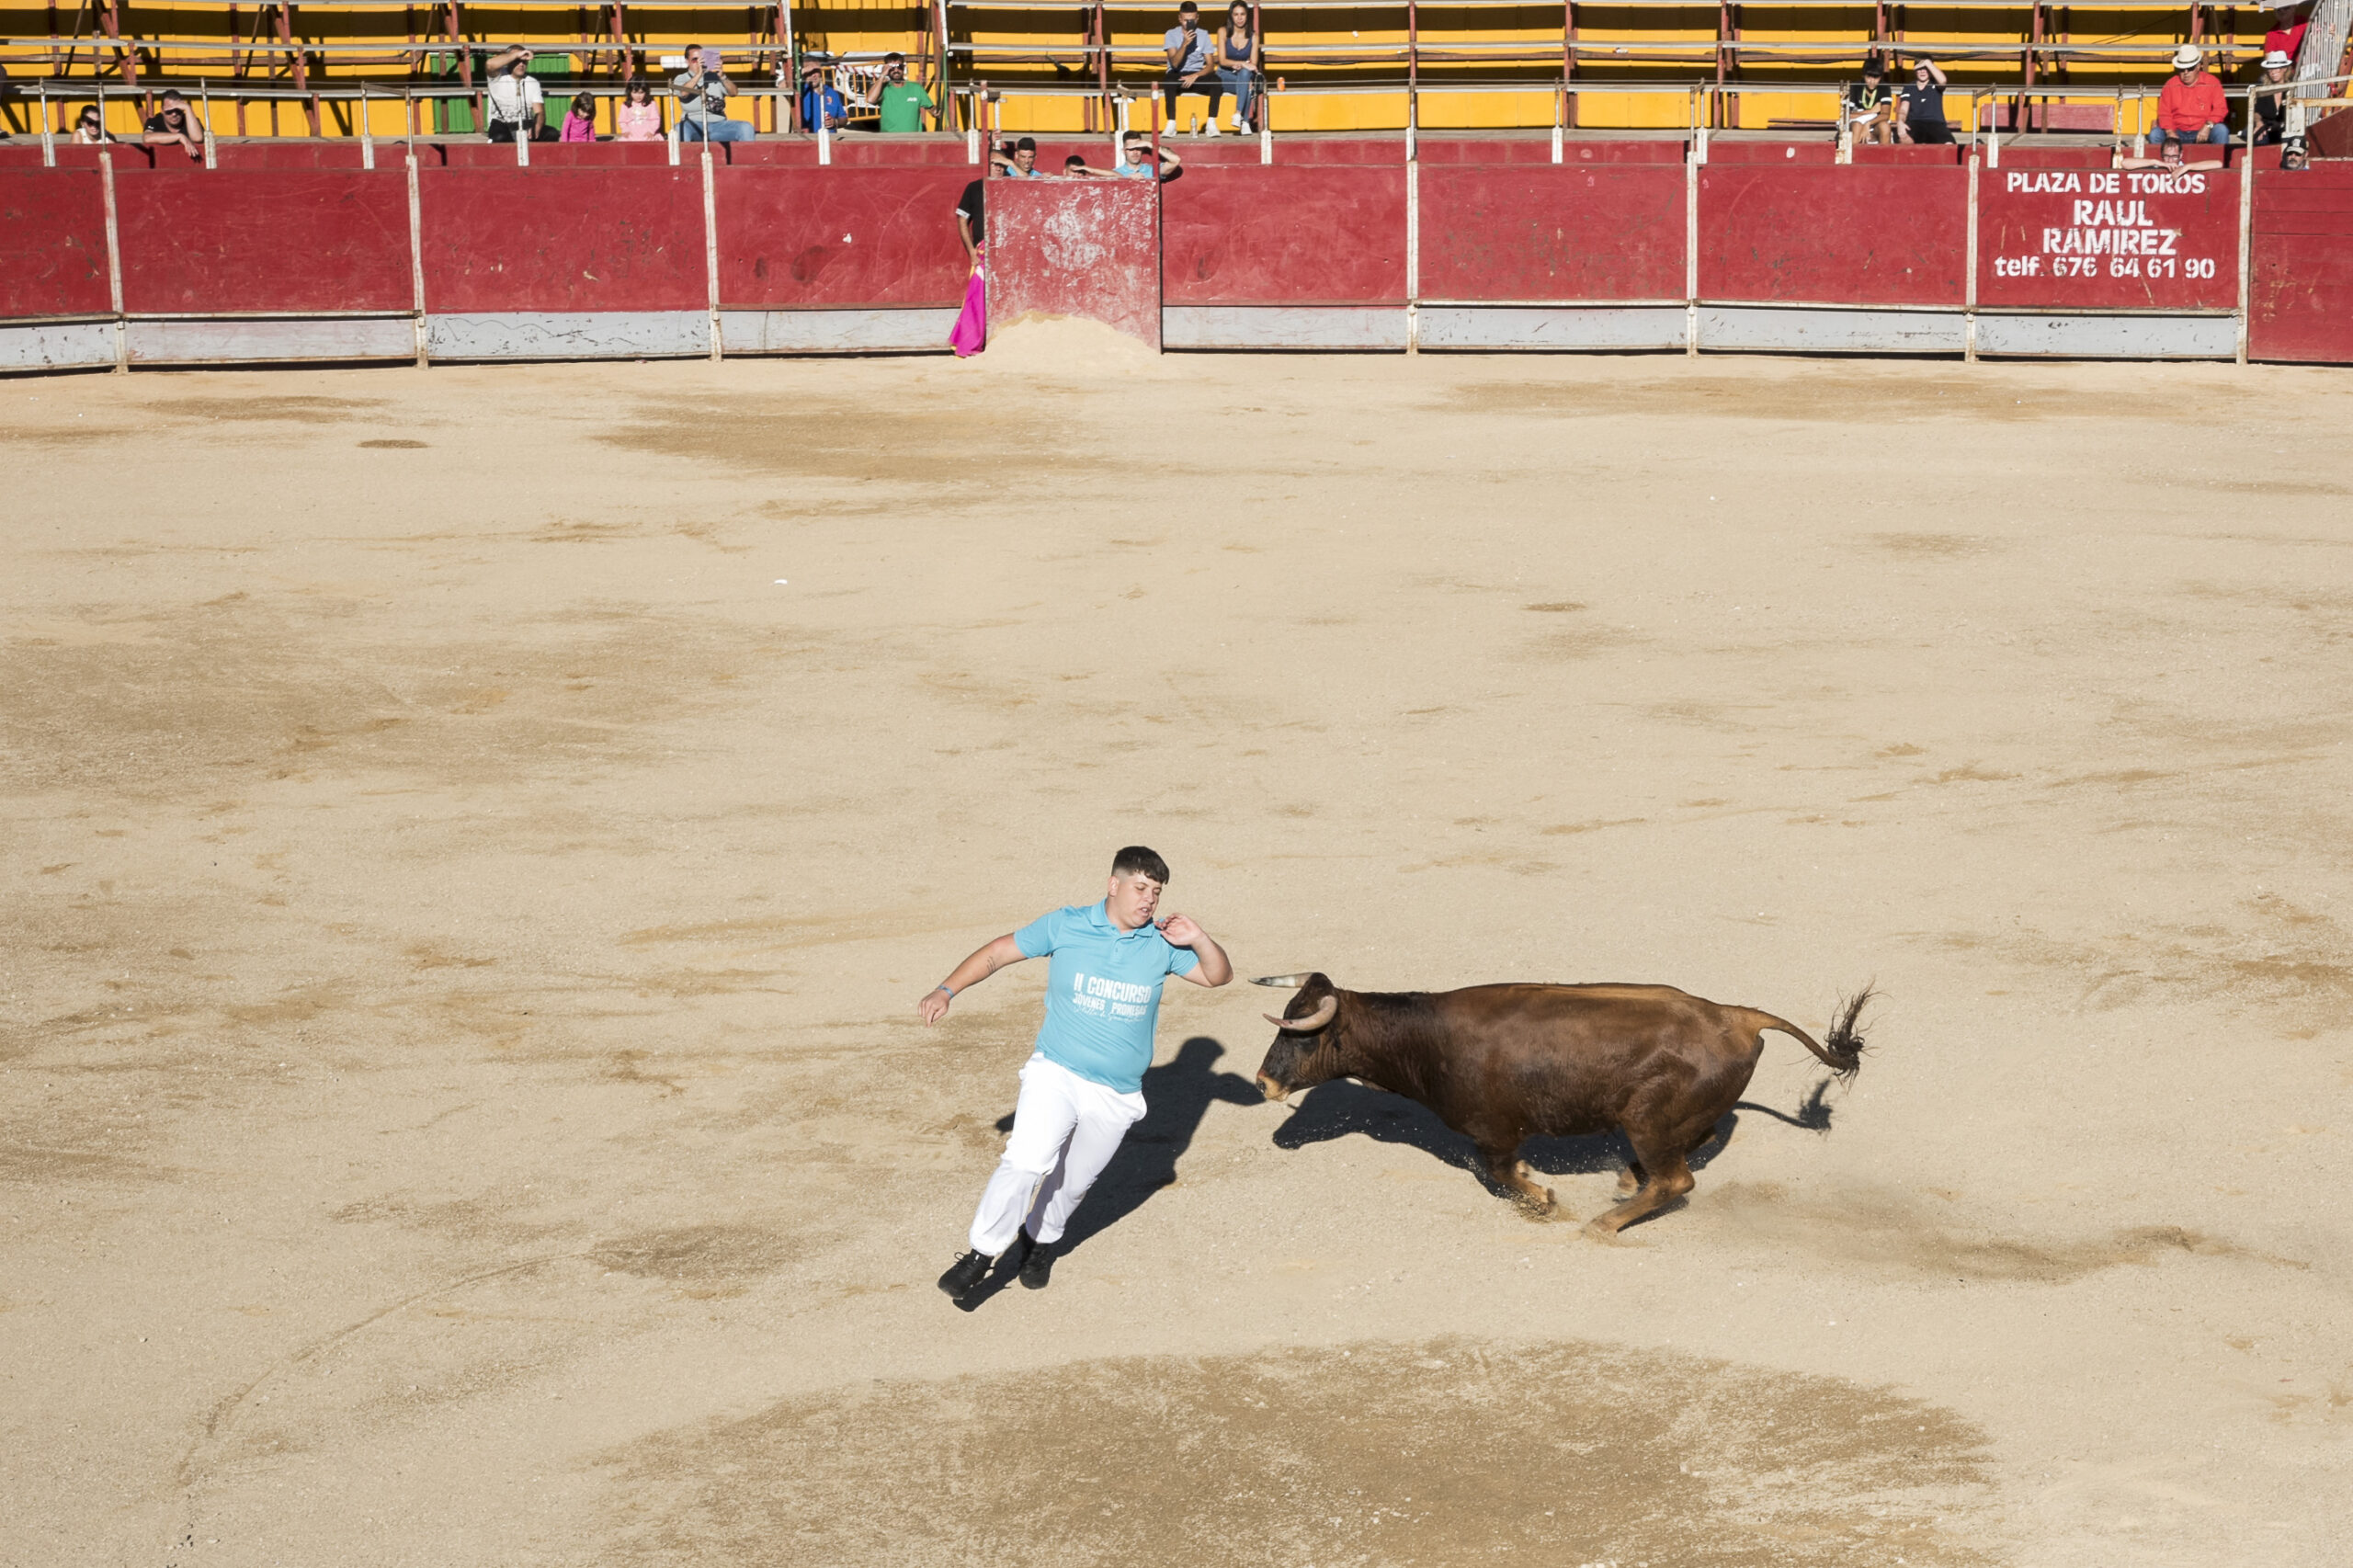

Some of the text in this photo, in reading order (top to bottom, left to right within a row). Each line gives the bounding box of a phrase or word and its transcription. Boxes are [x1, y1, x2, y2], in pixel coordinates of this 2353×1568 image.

[2007, 172, 2206, 194] PLAZA DE TOROS
[2074, 199, 2154, 226] RAUL
[2043, 228, 2177, 256] RAMIREZ
[1995, 256, 2215, 279] telf. 676 64 61 90
[1074, 972, 1152, 1004] II CONCURSO
[1110, 1002, 1148, 1017] PROMESAS
